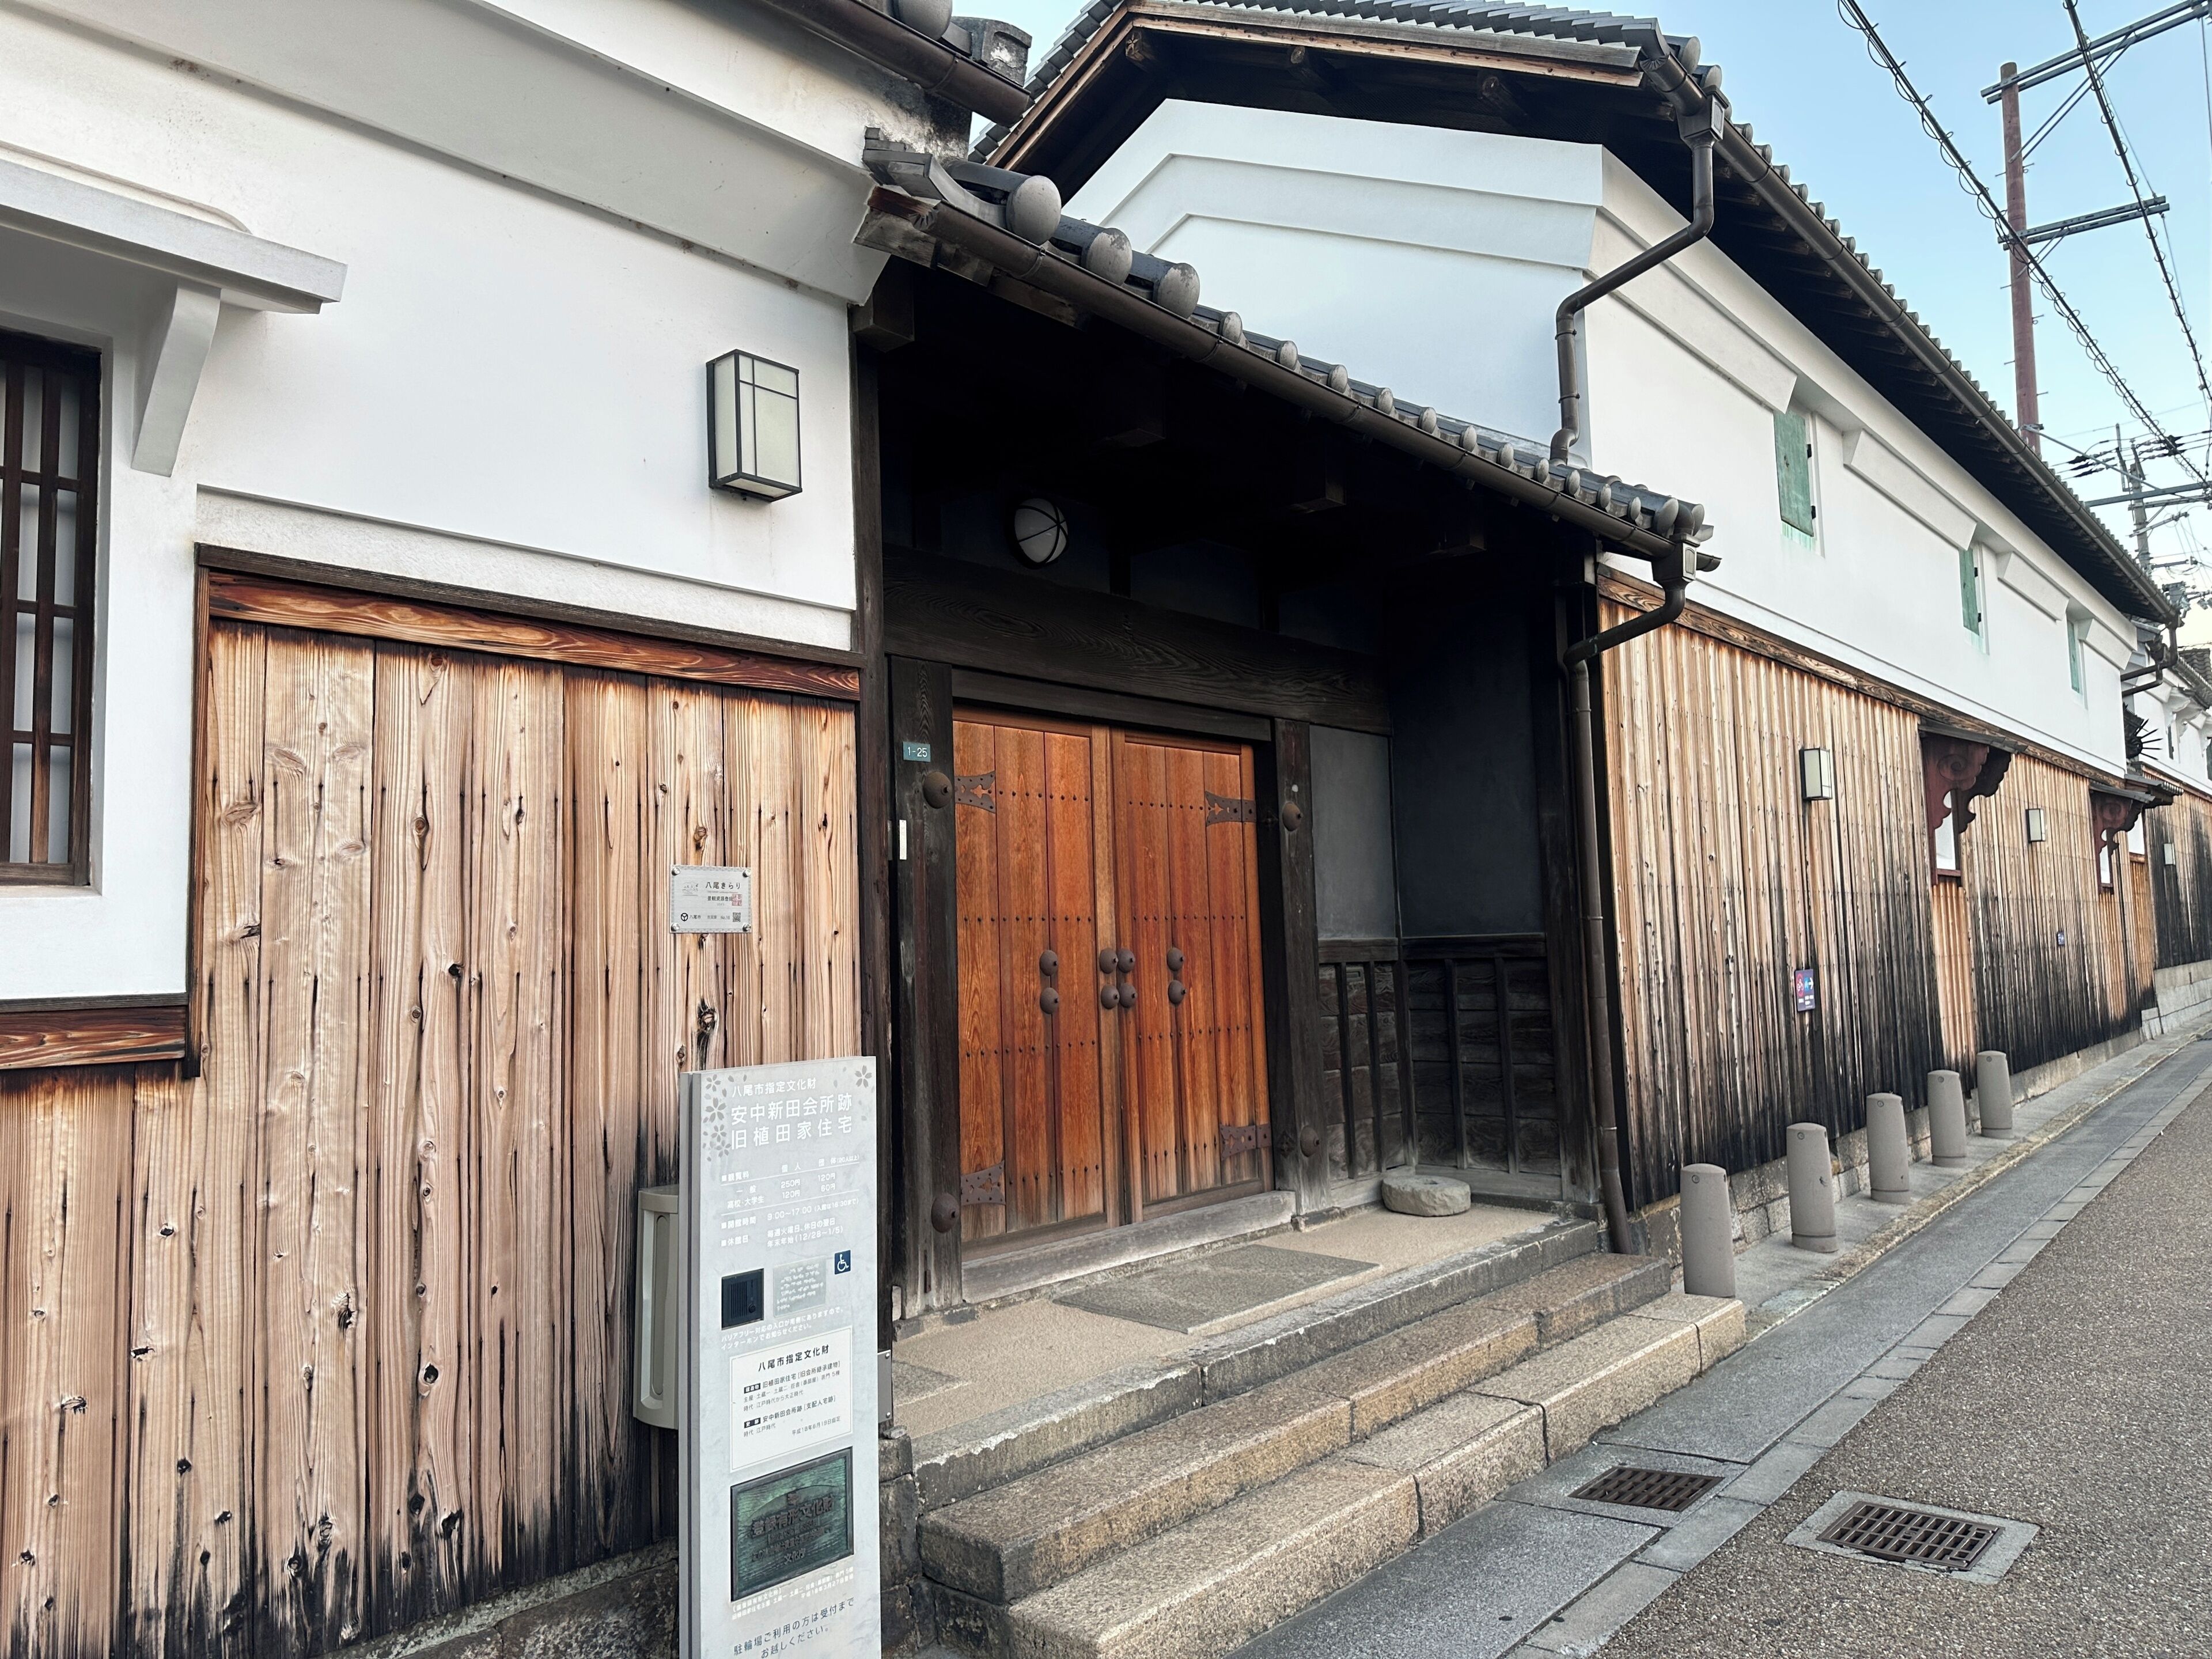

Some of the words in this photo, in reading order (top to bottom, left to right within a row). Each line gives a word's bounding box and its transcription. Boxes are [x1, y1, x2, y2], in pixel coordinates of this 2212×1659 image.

[907, 746, 927, 757] 1-25
[705, 881, 741, 890] 八尾きらり
[732, 1077, 817, 1098] 八尾市指定文化財
[731, 1093, 853, 1126] 安中新田会所跡
[731, 1115, 853, 1150] 旧植田家住宅
[781, 1179, 801, 1189] 250円
[817, 1172, 836, 1182] 120円
[782, 1190, 801, 1199] 120円
[820, 1183, 836, 1192] 60円
[728, 1234, 749, 1247] 休館日
[758, 1344, 830, 1372] 八尾市指定文化財
[752, 1492, 834, 1537] 登録有形文化財
[733, 1596, 855, 1657] 駐輪場ご利用の方は受付まで
[761, 1625, 830, 1659] お越しください。
